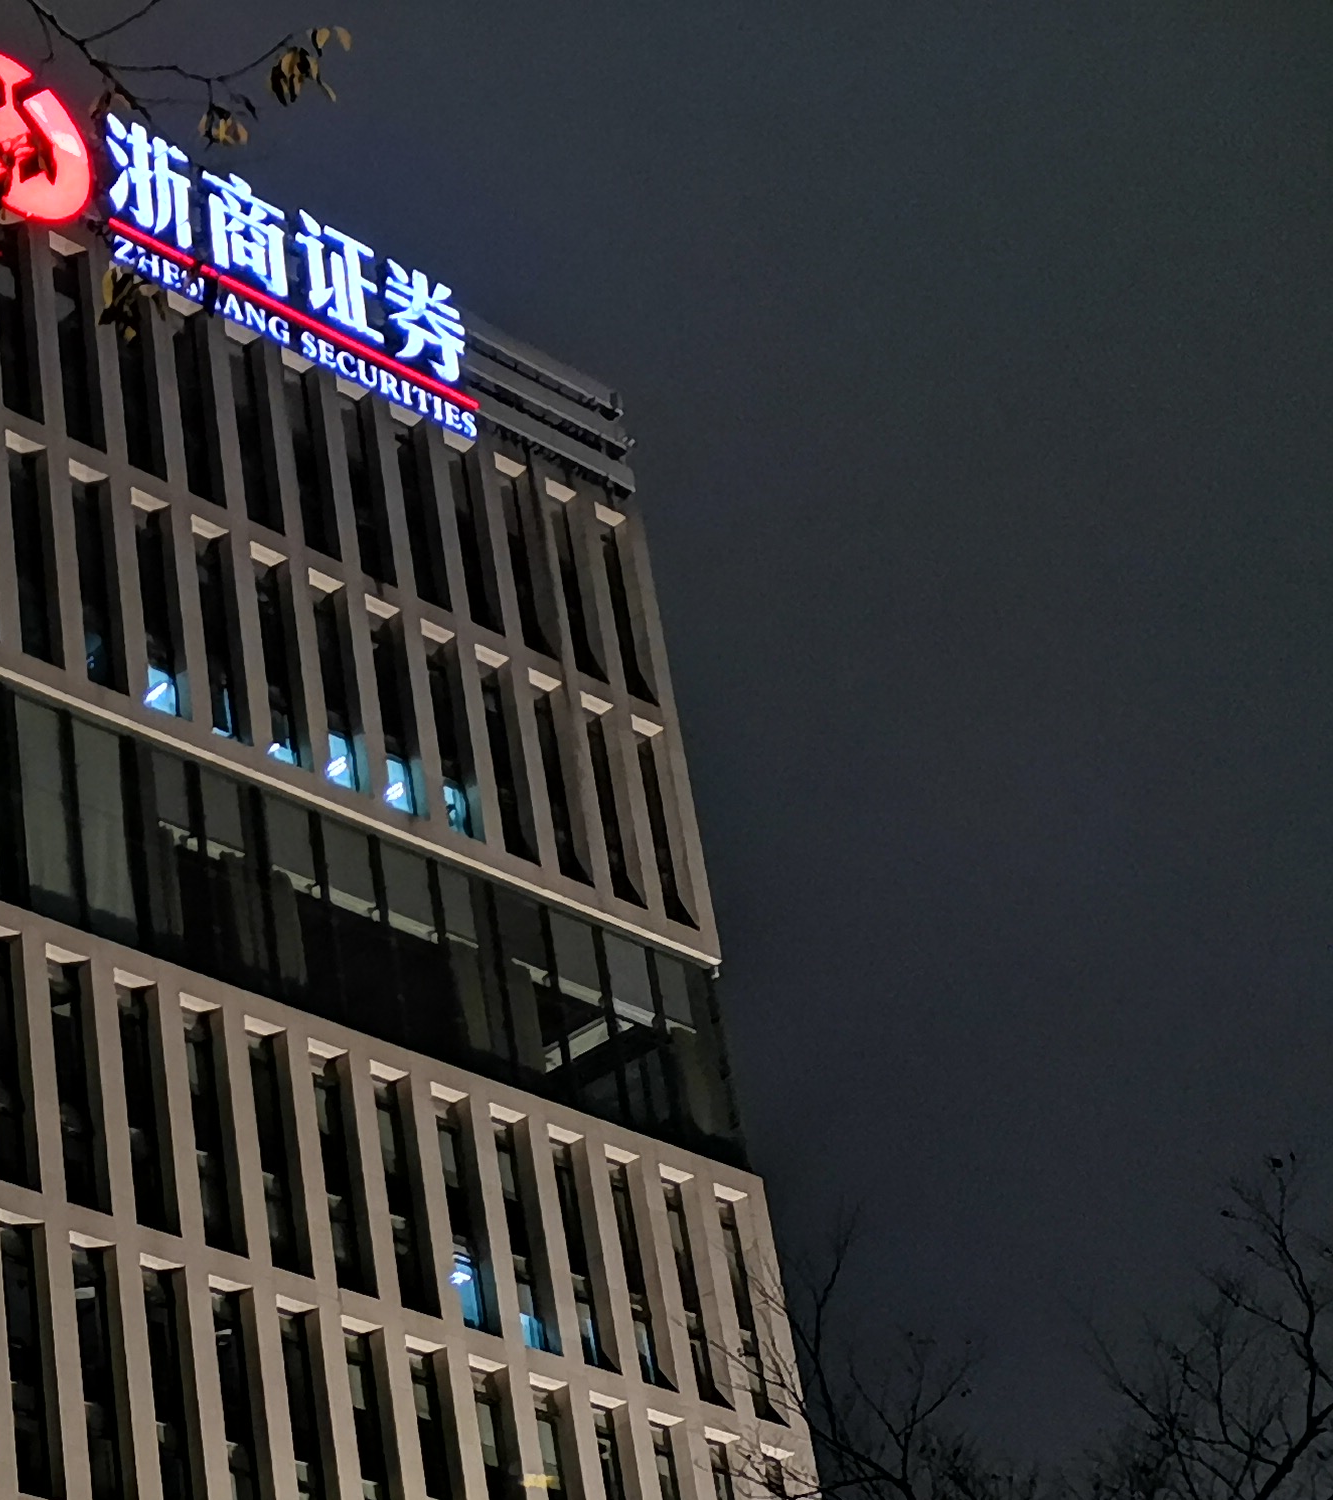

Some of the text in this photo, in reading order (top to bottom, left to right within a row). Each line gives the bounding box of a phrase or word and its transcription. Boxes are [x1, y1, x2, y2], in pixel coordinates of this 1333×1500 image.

[105, 112, 465, 382] 浙商证券
[301, 331, 478, 437] SECURITIES
